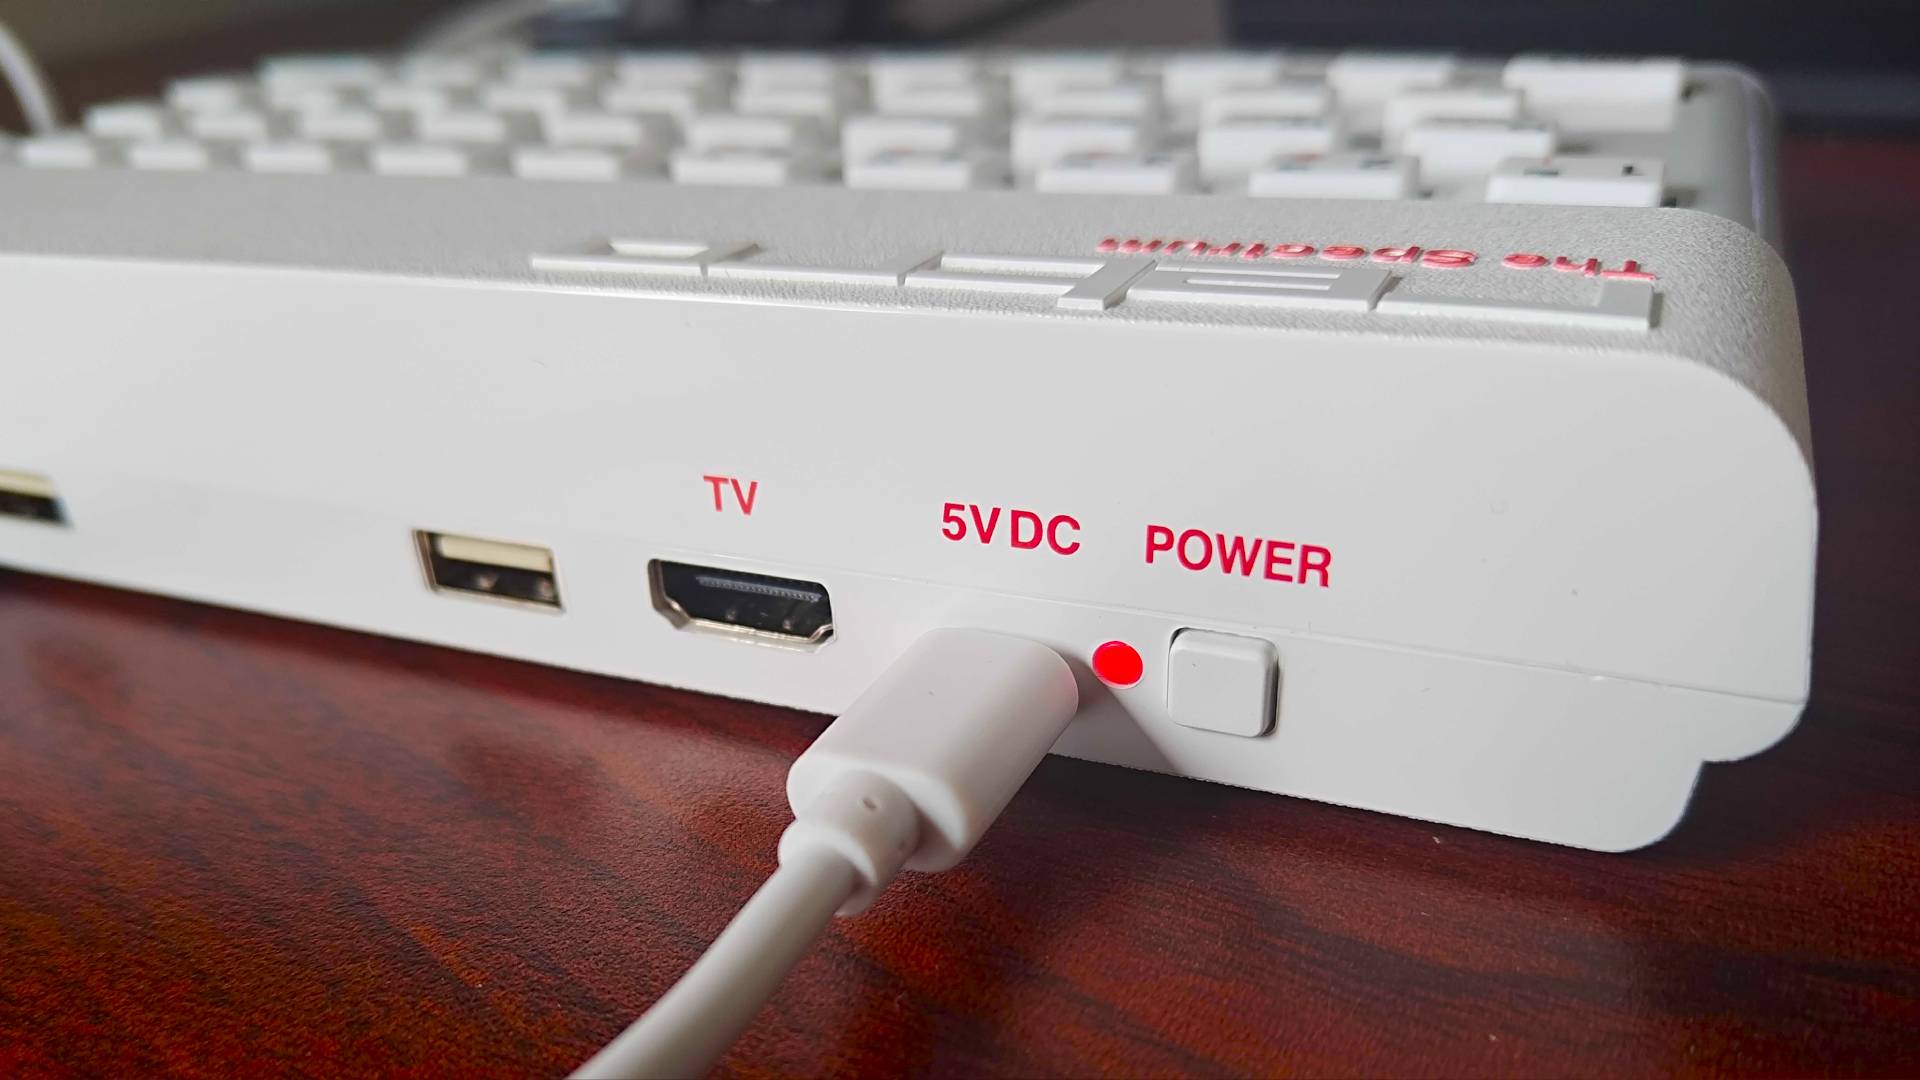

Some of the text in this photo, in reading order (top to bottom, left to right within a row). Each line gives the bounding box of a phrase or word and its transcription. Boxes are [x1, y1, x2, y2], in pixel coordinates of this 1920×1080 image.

[1097, 235, 1657, 282] The Spectrum
[702, 475, 759, 516] TV
[941, 502, 1082, 557] 5V DC
[1144, 523, 1333, 589] POWER
